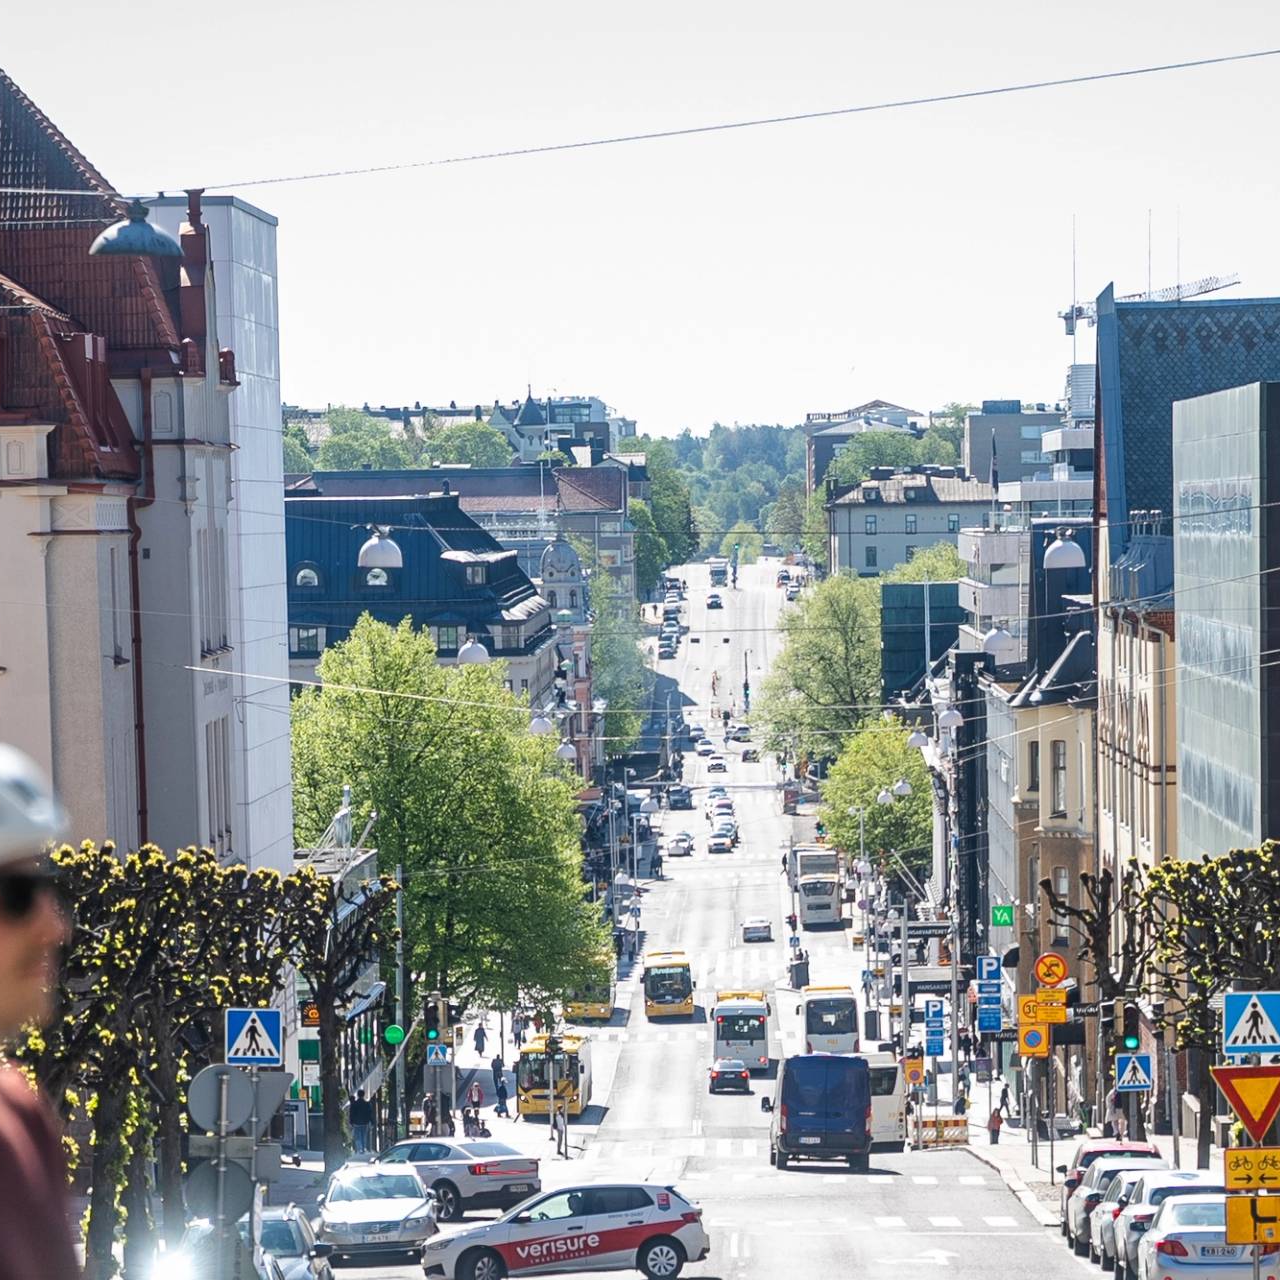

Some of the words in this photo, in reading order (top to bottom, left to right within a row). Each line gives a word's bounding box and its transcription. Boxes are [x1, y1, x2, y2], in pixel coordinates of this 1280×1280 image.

[994, 909, 1011, 923] YA
[982, 958, 998, 979] P
[929, 1001, 941, 1018] P
[516, 1232, 600, 1259] verisure
